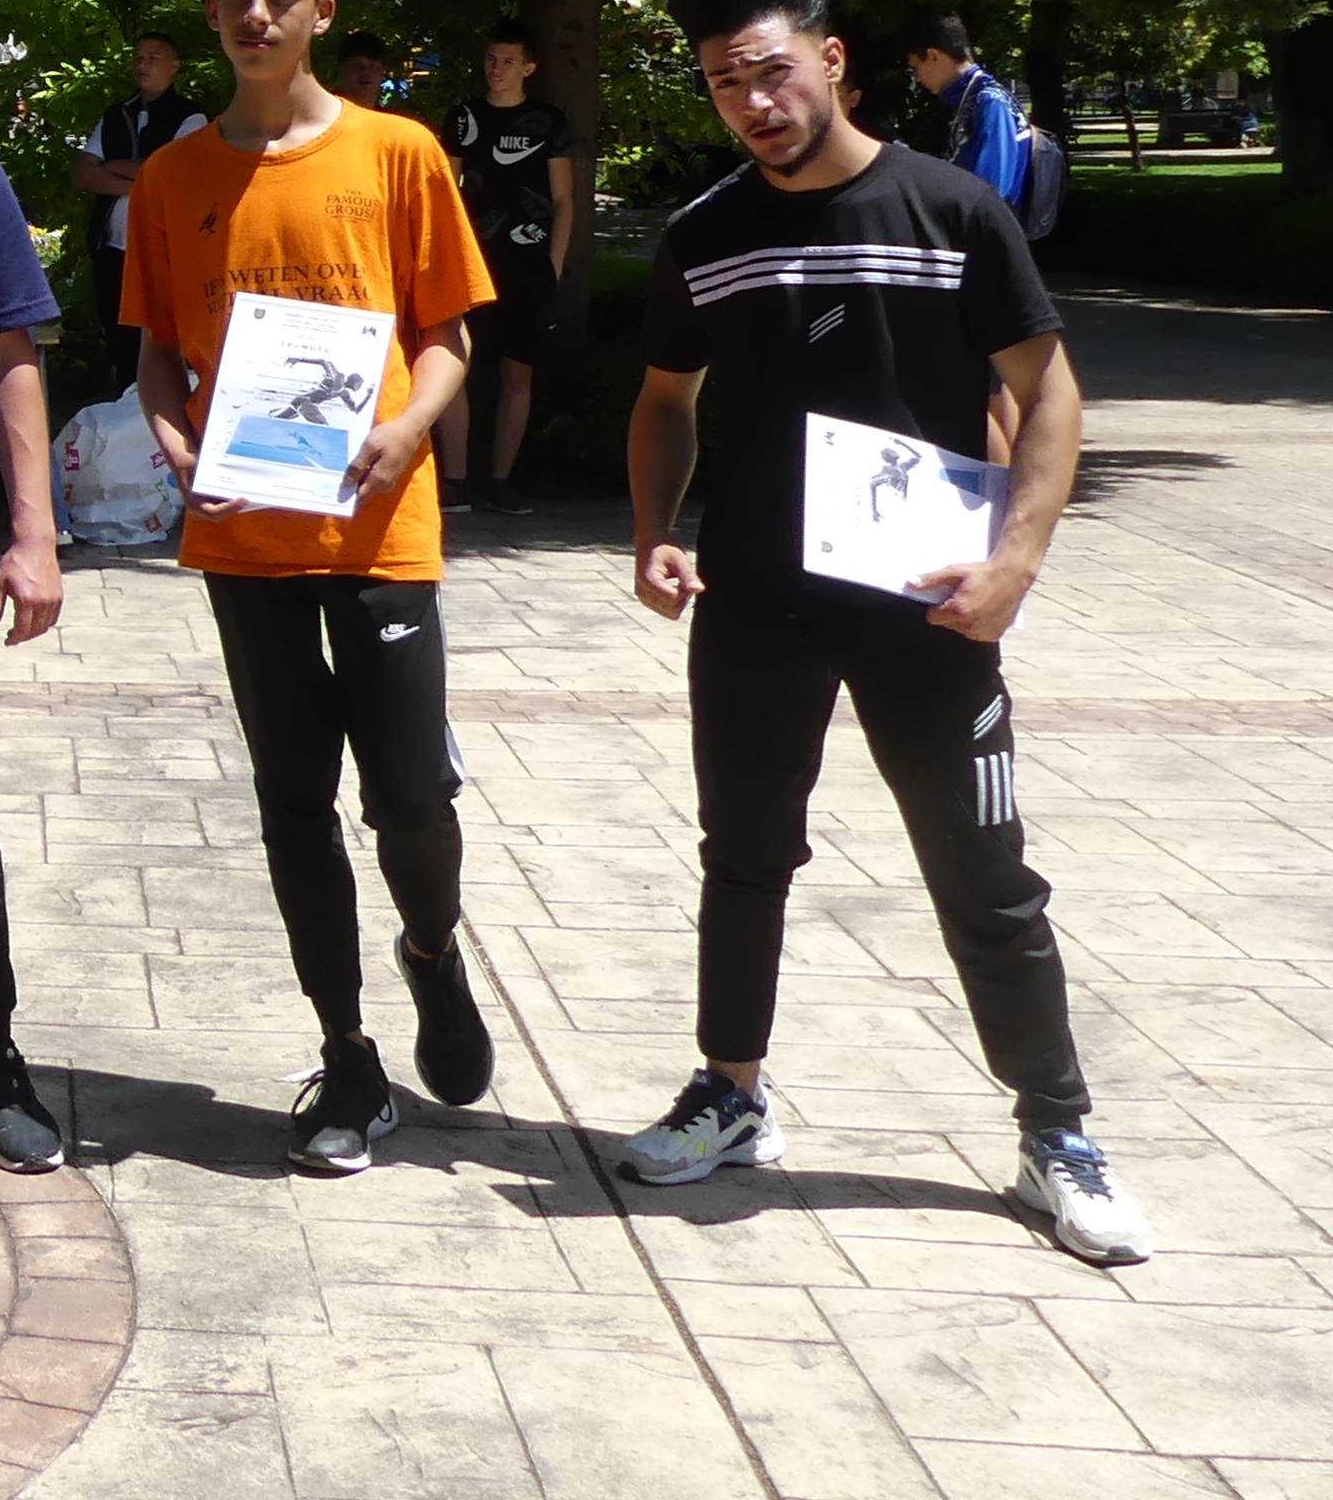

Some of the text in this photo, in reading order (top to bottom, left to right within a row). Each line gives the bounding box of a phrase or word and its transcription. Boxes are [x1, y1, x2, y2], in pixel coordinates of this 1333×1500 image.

[499, 135, 530, 150] NIKE
[326, 194, 380, 208] FAMOUS
[324, 204, 376, 219] GROUSE
[228, 264, 310, 285] WETEN
[317, 262, 366, 279] OVE
